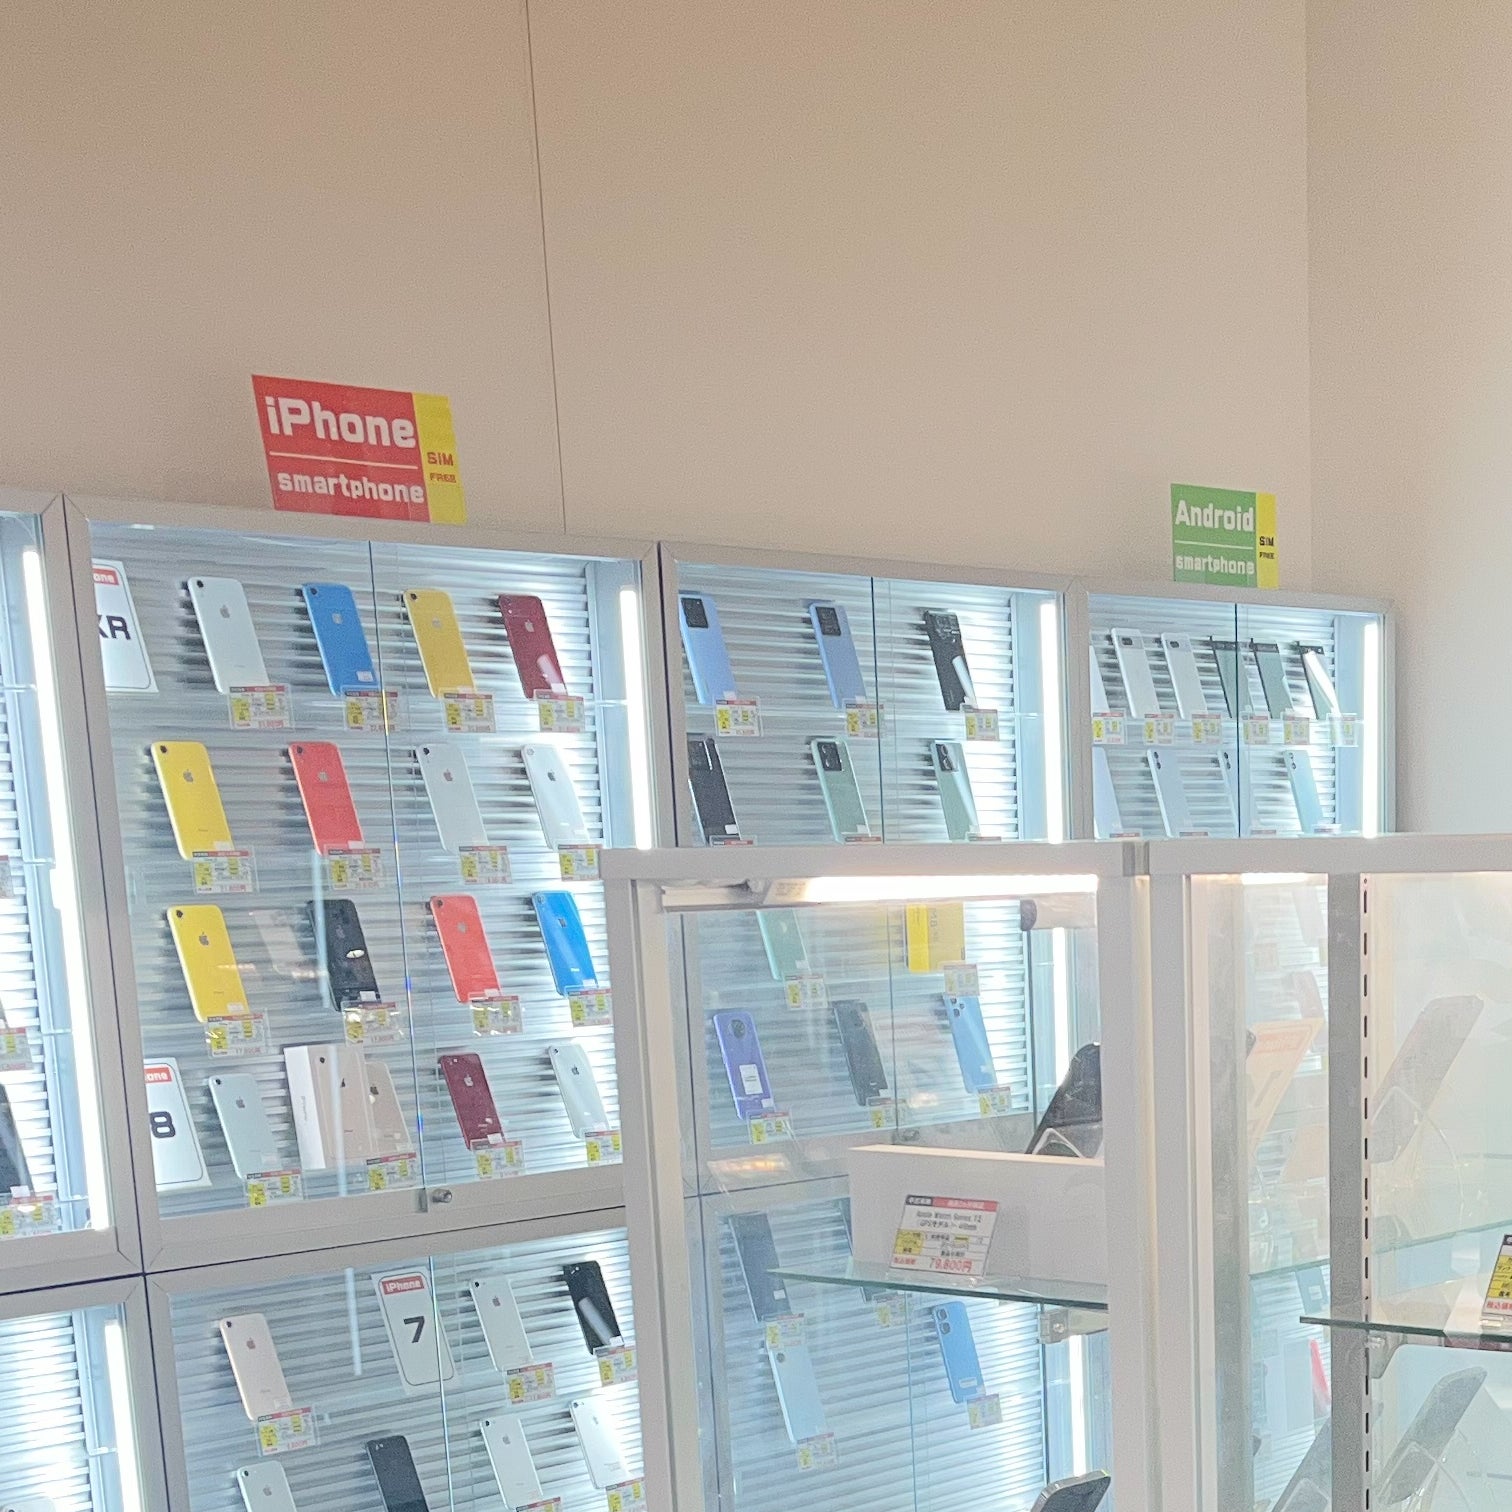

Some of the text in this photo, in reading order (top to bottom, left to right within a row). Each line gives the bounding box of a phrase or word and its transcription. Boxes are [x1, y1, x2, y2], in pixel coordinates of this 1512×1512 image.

[265, 396, 416, 448] iPhone
[427, 452, 454, 466] SIM
[430, 472, 456, 484] FREE
[277, 472, 425, 503] smartphone
[1175, 500, 1254, 531] Android
[1260, 536, 1274, 546] SIM
[1175, 555, 1255, 575] smartphone
[93, 573, 115, 584] one
[144, 1070, 169, 1082] one
[149, 1111, 176, 1139] 8
[385, 1278, 421, 1294] iPhone
[403, 1315, 425, 1343] 7
